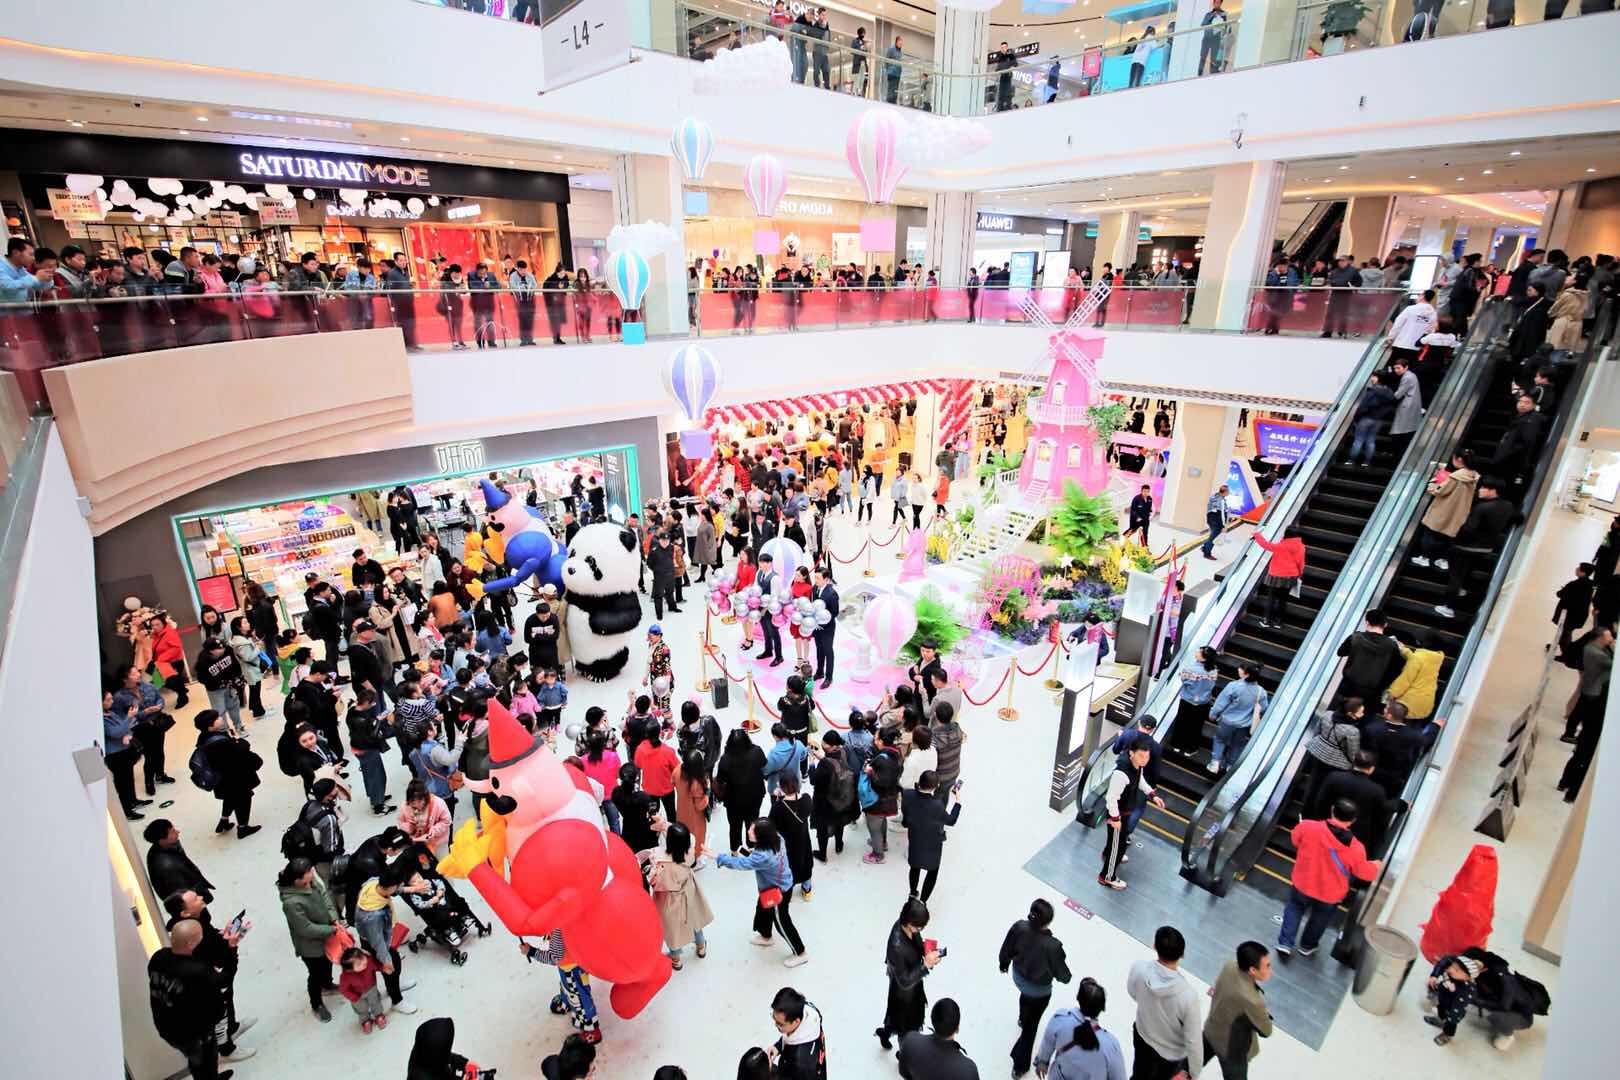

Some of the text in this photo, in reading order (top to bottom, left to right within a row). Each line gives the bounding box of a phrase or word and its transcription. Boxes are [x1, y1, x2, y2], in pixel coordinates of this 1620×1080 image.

[573, 20, 590, 50] L4
[800, 203, 833, 216] MODA
[978, 215, 1014, 230] HUAWEI
